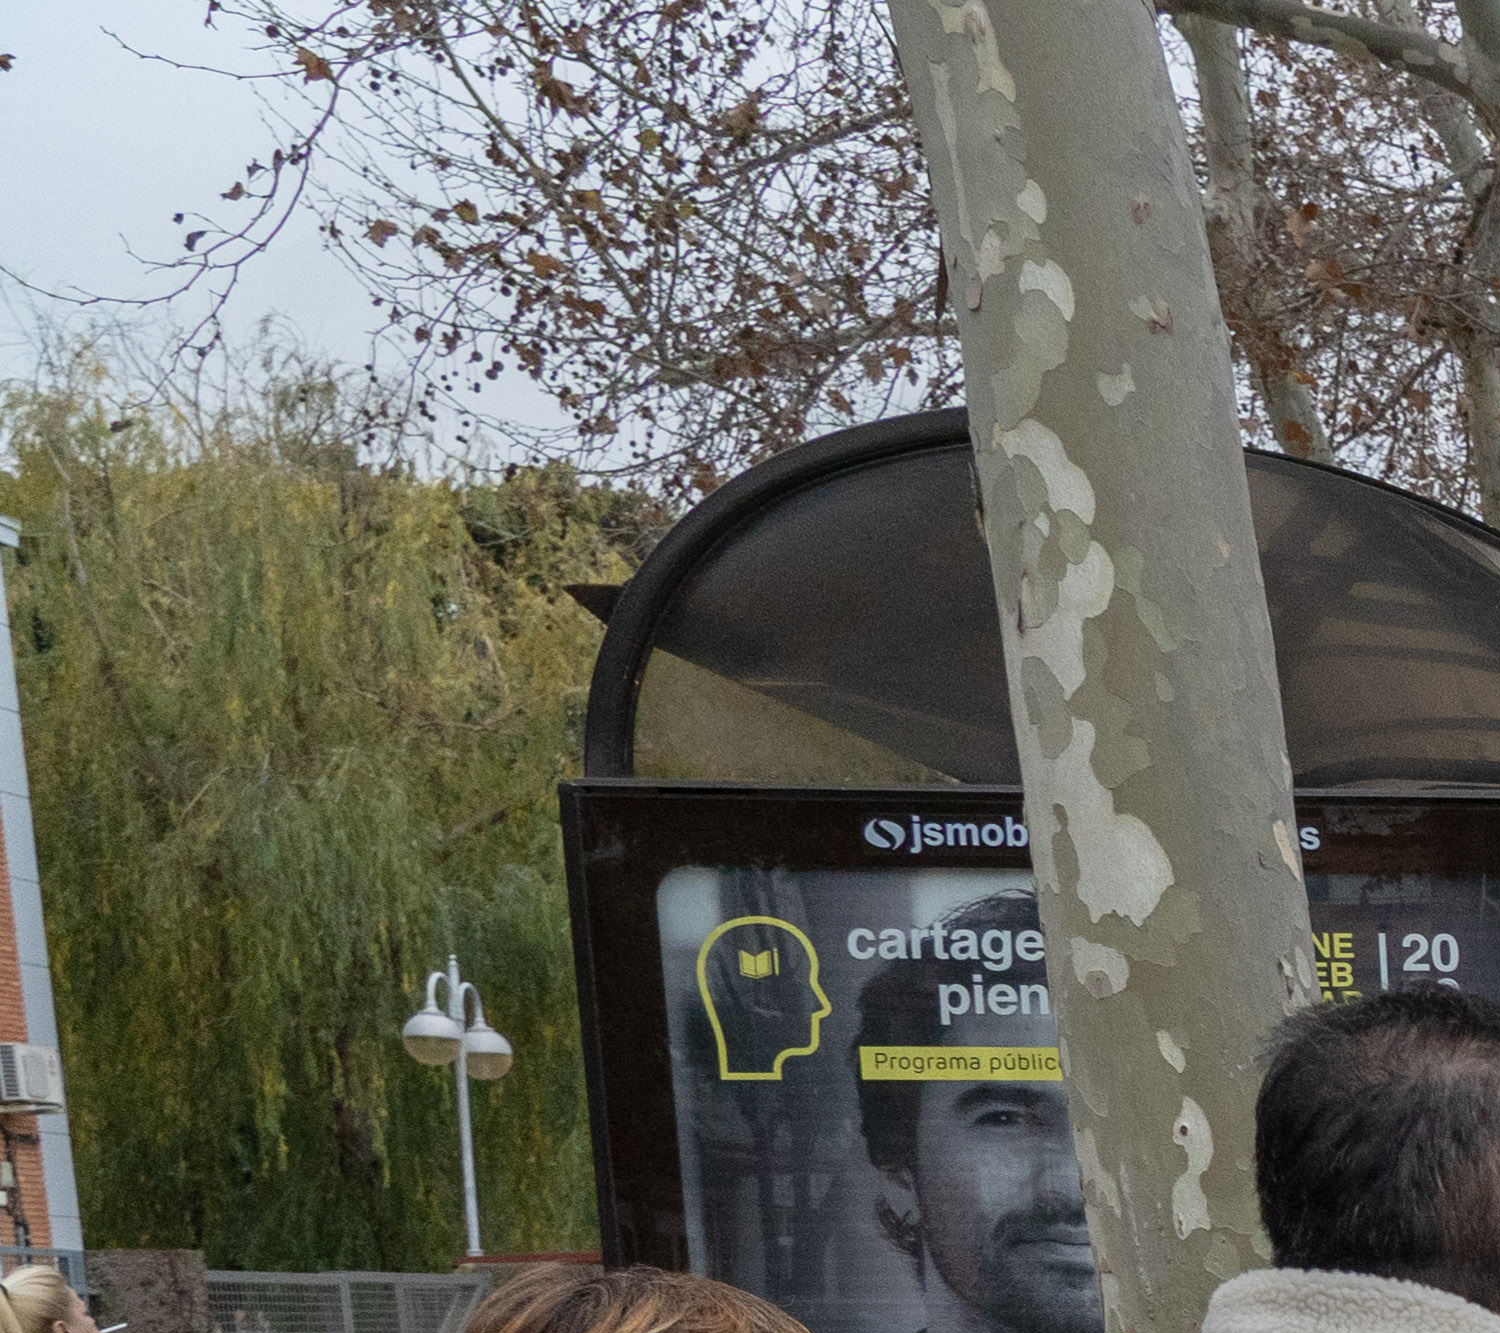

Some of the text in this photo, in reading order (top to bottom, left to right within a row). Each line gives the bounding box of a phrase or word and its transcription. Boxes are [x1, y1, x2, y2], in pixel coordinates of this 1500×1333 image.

[910, 815, 1029, 853] jsmob
[847, 921, 1045, 971] cartage
[1402, 933, 1460, 972] 20
[938, 974, 1049, 1026] pien
[874, 1052, 1060, 1075] Programa públic
